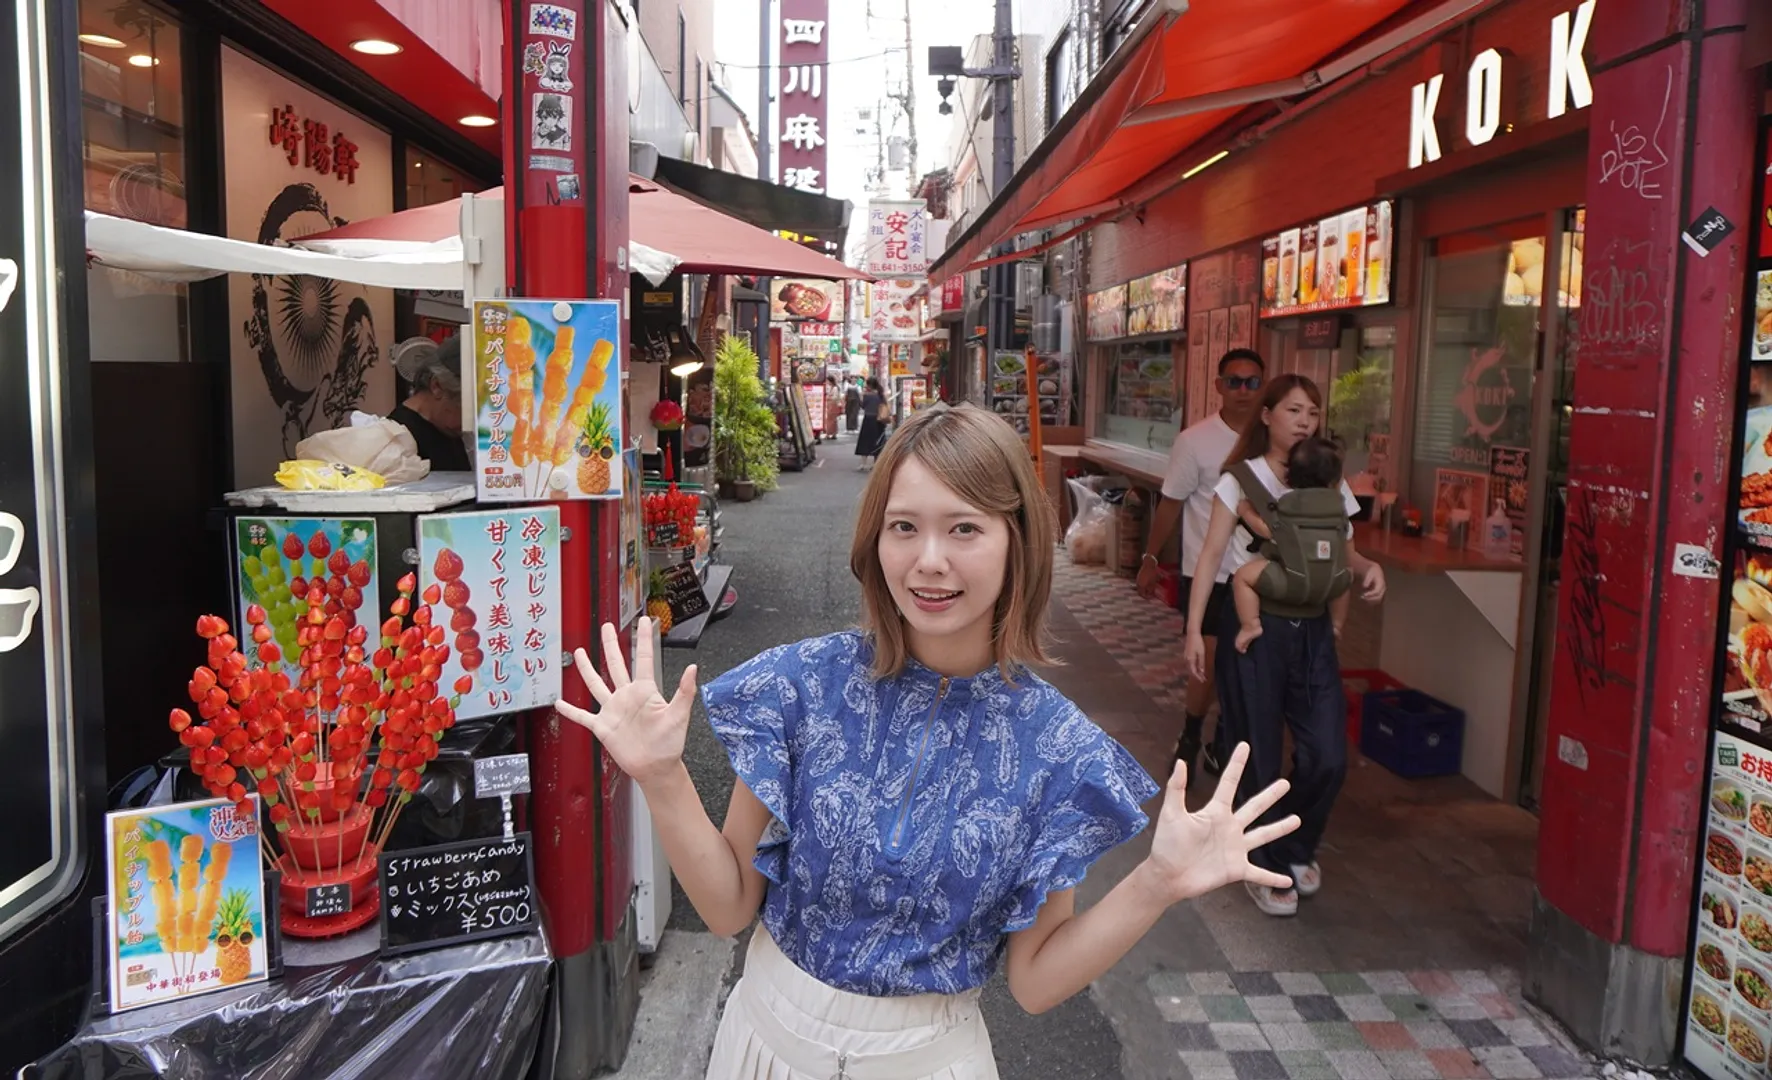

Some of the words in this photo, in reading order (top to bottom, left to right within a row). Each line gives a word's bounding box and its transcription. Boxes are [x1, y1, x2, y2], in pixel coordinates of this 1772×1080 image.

[781, 18, 826, 195] 四川麻婆
[871, 209, 884, 236] 元祖
[885, 211, 909, 261] 安記
[909, 209, 924, 254] 大小宴会
[485, 338, 508, 463] パイナップル飴
[487, 519, 512, 708] 甘くて美味しい
[521, 515, 547, 676] 冷凍じゃない
[124, 828, 144, 945] パイナップル飴
[407, 869, 501, 895] いちごあめ
[461, 902, 530, 934] ¥500
[146, 967, 222, 993] 中華街初登場
